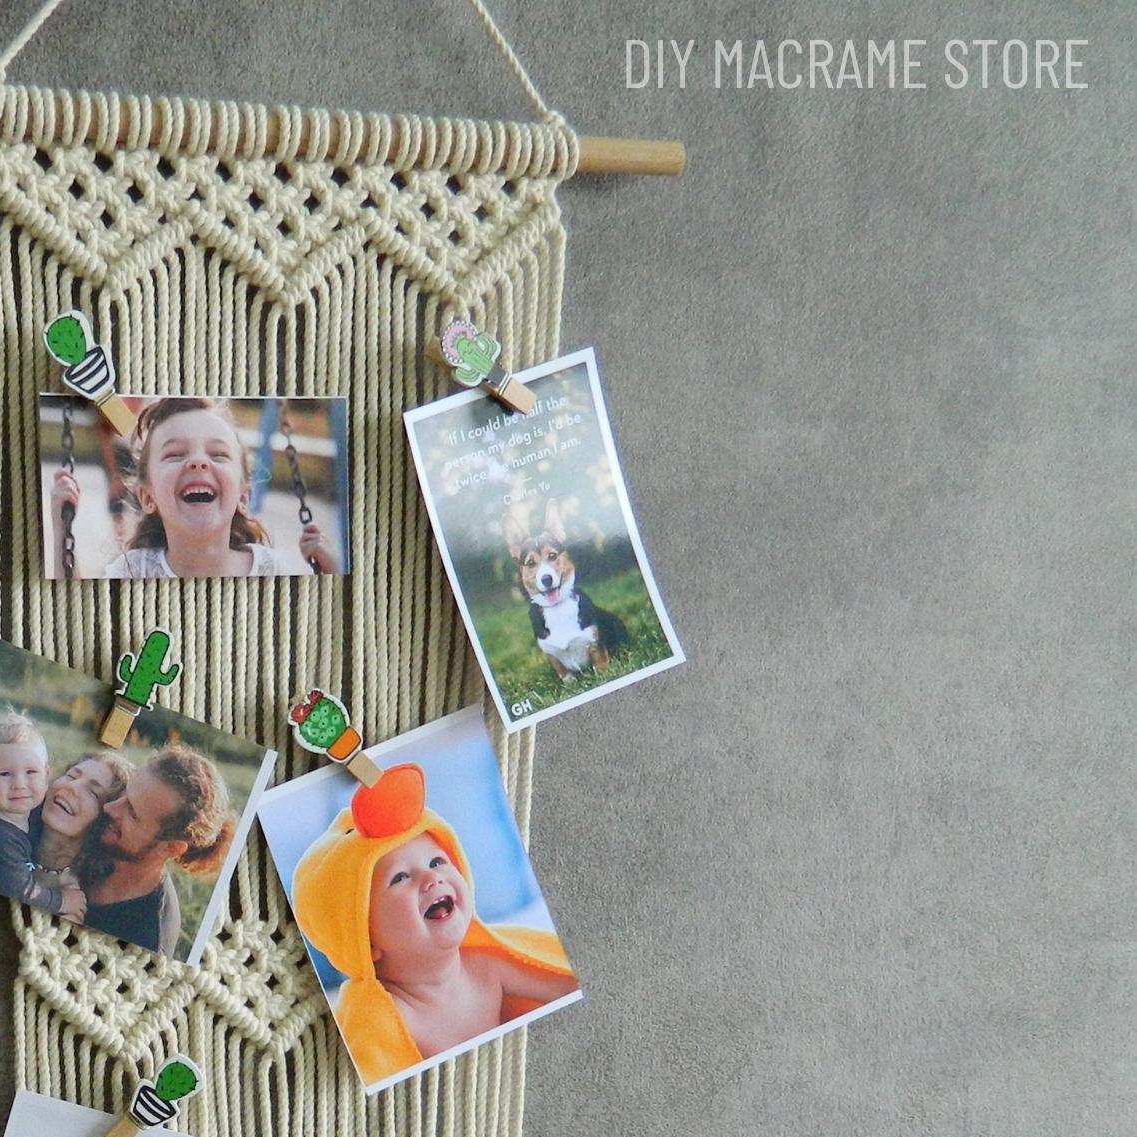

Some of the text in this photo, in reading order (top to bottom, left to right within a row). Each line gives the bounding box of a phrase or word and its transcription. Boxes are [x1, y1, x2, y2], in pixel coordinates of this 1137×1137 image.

[468, 415, 501, 439] could
[502, 412, 519, 426] be
[546, 396, 568, 411] the
[488, 440, 505, 455] my
[508, 432, 532, 448] dog
[565, 413, 582, 426] be
[455, 471, 487, 489] twice
[511, 447, 552, 468] human
[511, 699, 532, 716] GH
